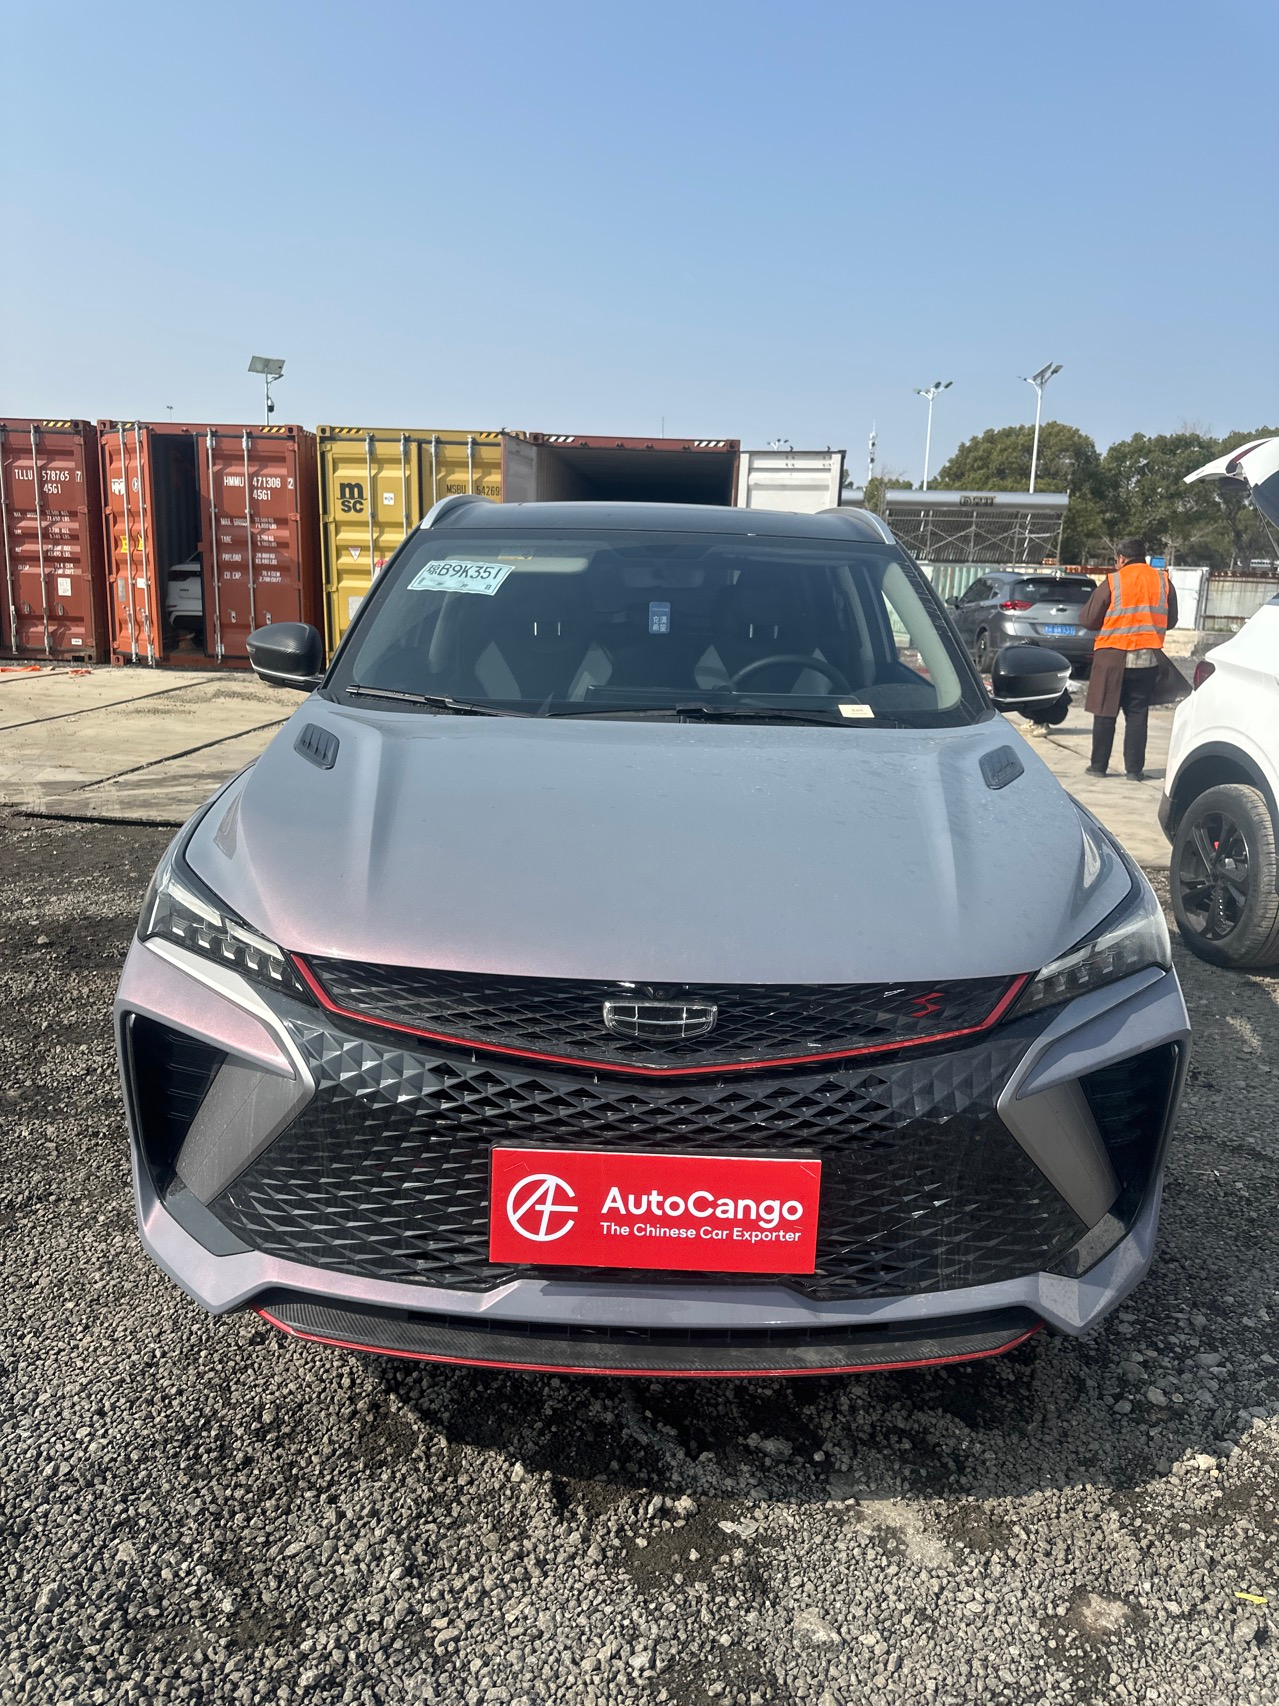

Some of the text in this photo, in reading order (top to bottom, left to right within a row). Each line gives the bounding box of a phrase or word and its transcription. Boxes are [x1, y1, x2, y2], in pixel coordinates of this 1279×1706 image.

[15, 470, 82, 482] TLLU 578765 7
[224, 476, 294, 489] HMMU 471306 2
[44, 484, 61, 494] 45G1
[253, 490, 271, 500] 45G1
[446, 484, 502, 496] MSBU 54269
[601, 1186, 803, 1228] AutoCango
[600, 1222, 801, 1243] The Chinese Car Exporter
